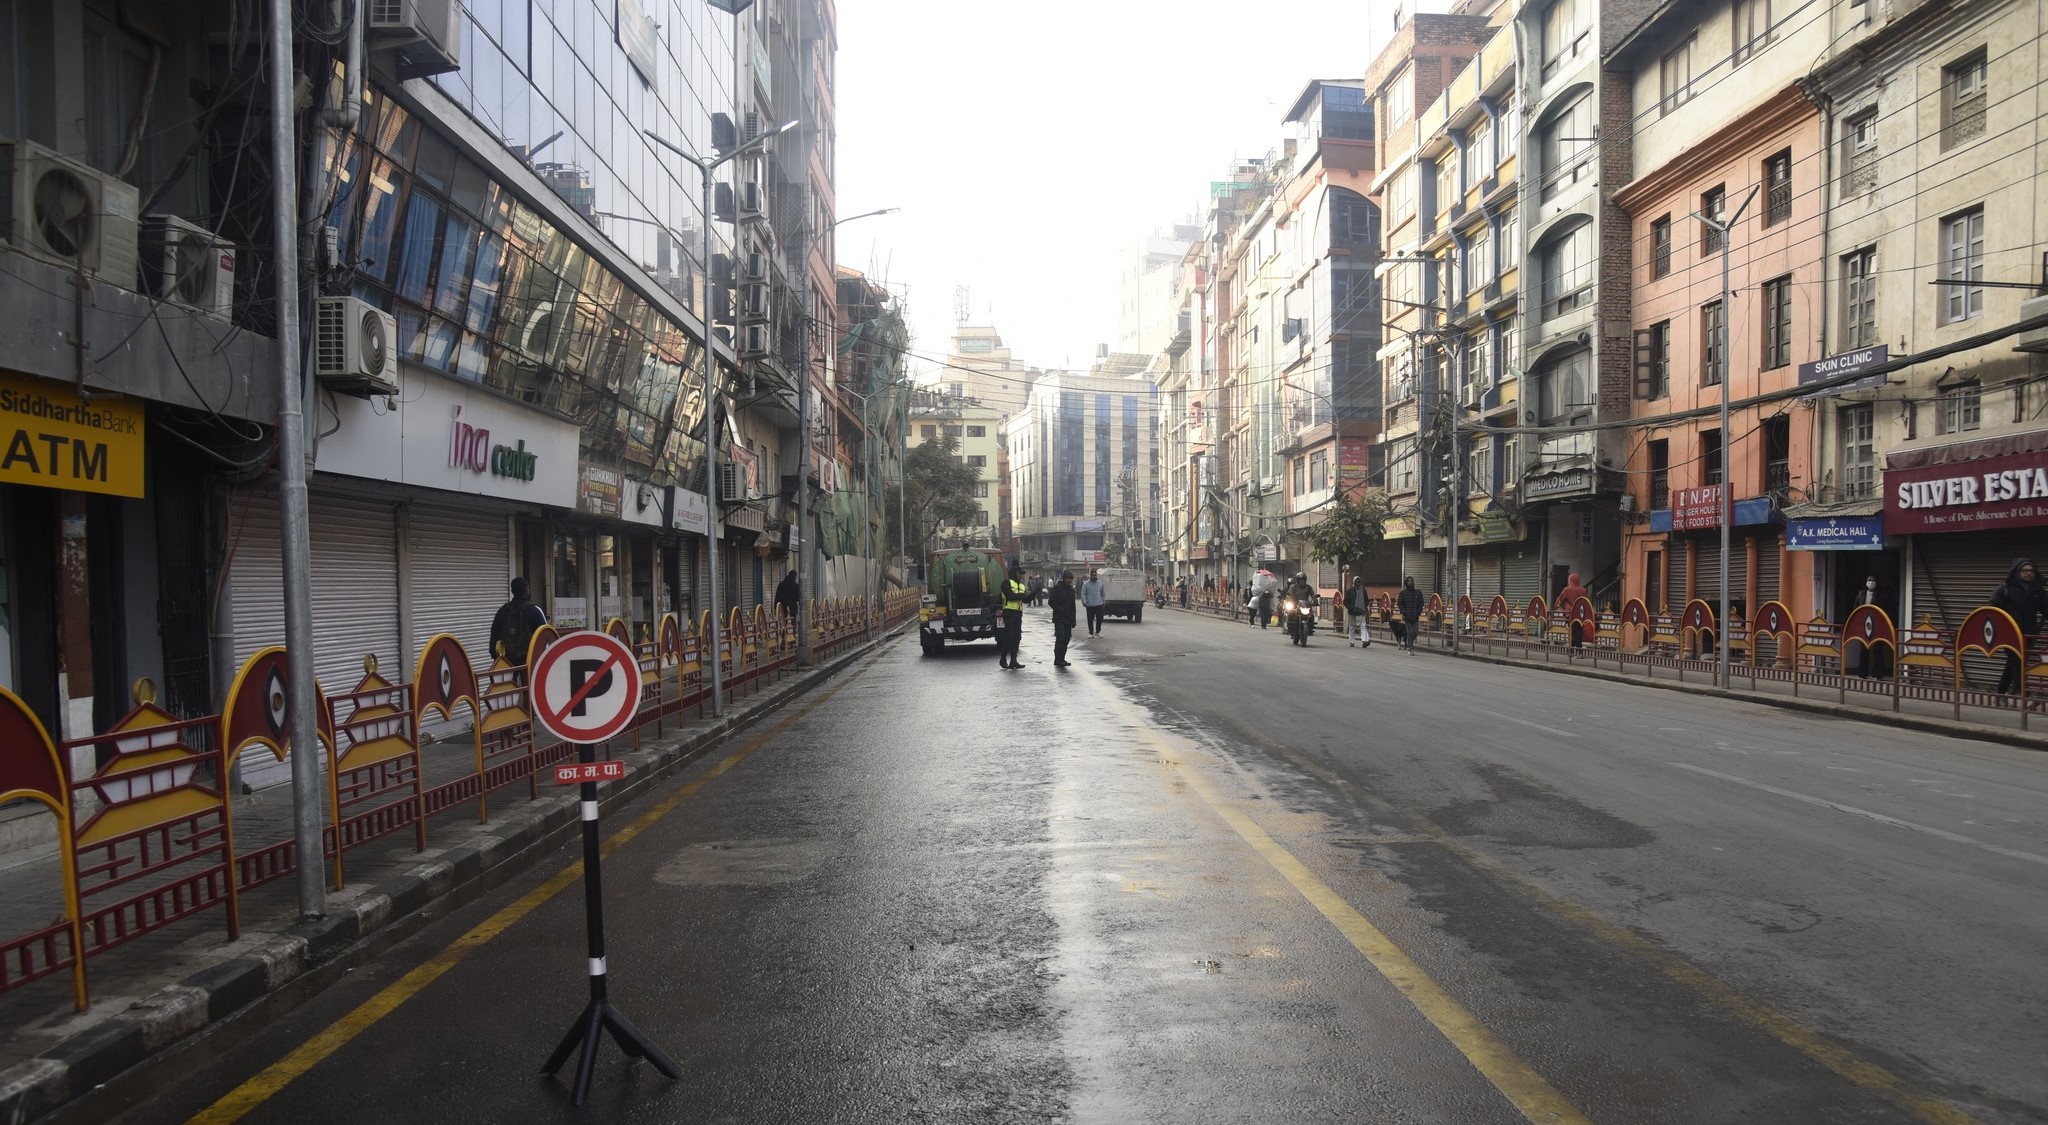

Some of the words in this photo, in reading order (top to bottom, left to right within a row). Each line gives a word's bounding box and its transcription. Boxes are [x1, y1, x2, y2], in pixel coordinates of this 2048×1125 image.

[1815, 359, 1838, 373] SKIN
[1840, 351, 1872, 368] CLINIC
[1, 429, 108, 482] ATM
[1531, 476, 1558, 492] MEDICO
[1560, 472, 1581, 487] HOME
[1898, 476, 1980, 509] SILVER
[1983, 467, 2048, 502] ESTA
[1676, 507, 1698, 518] BUGER
[1690, 517, 1704, 527] FOOD
[1923, 515, 1929, 524] A
[1948, 513, 1956, 522] of
[2018, 506, 2034, 517] Gift
[1816, 527, 1848, 537] MEDICAL
[1849, 526, 1867, 536] HALL
[570, 659, 614, 717] P
[584, 765, 600, 777] म.
[603, 764, 621, 776] पा.
